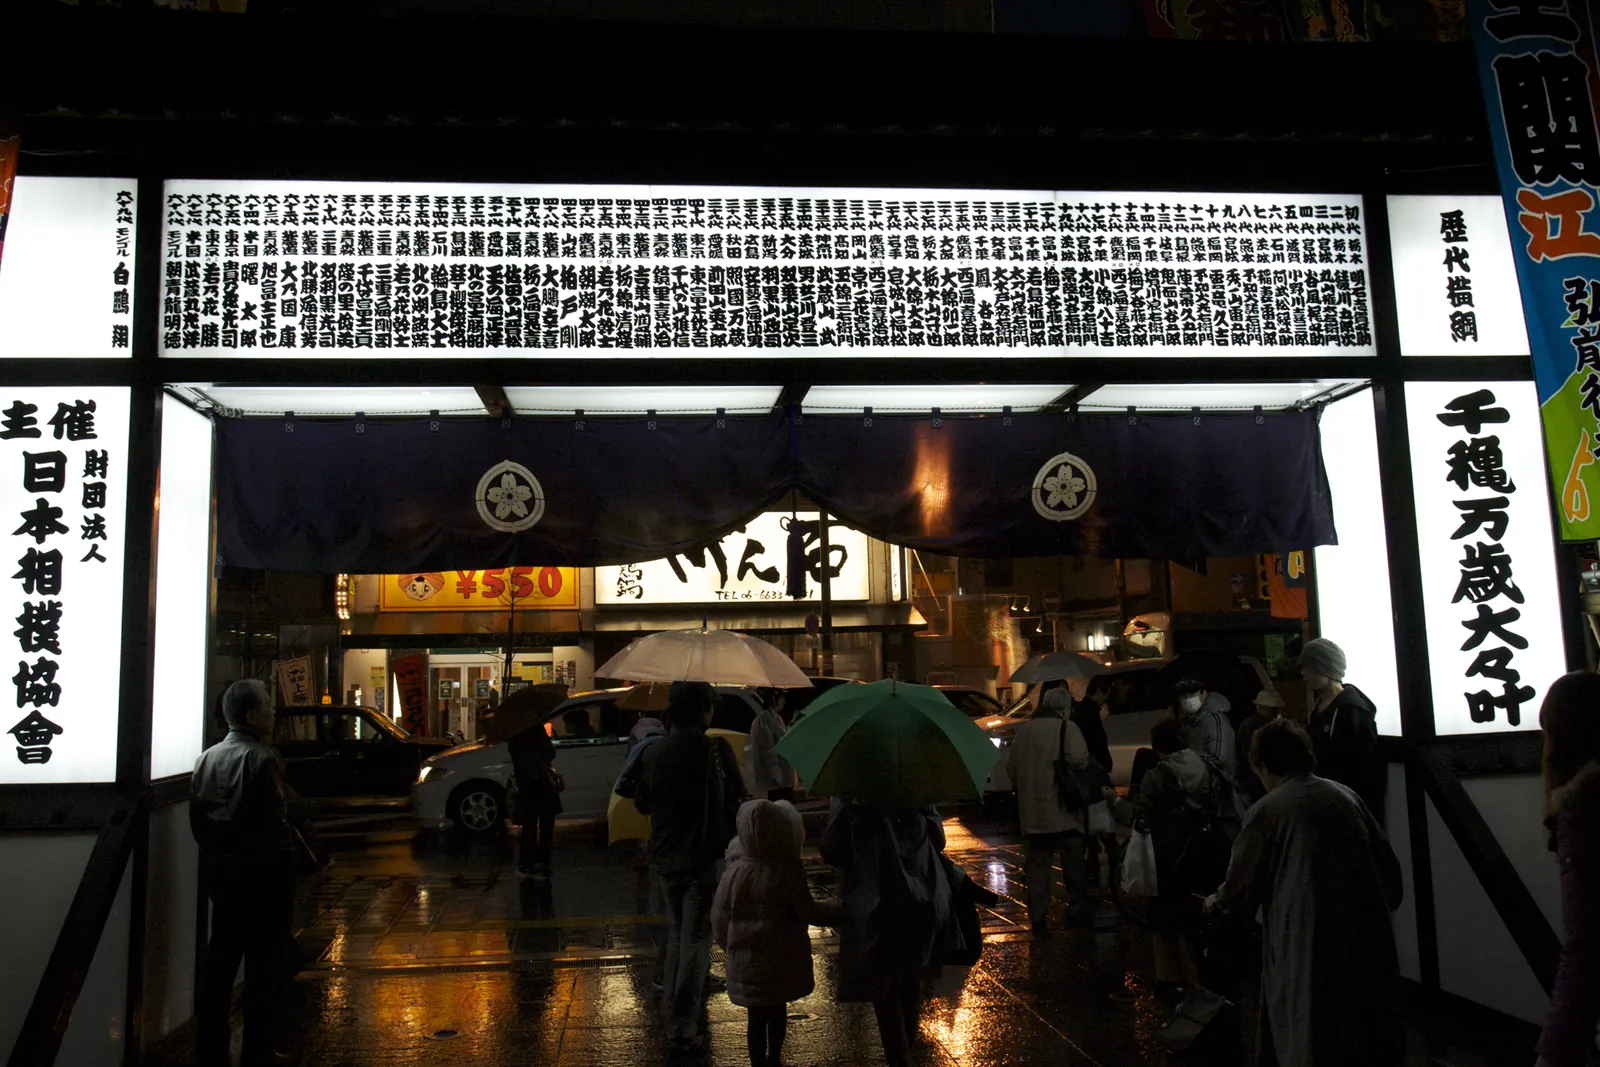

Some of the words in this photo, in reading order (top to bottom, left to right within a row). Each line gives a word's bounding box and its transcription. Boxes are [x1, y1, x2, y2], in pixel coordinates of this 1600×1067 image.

[115, 190, 134, 225] 六十九代
[166, 193, 185, 226] 六十八代
[185, 193, 204, 226] 六十七代
[223, 194, 242, 226] 六十五代
[262, 194, 280, 226] 六十三代
[301, 193, 320, 226] 六十一代
[321, 194, 338, 225] 六十代
[338, 194, 357, 226] 五十九代
[358, 194, 375, 226] 五十八代
[376, 194, 393, 226] 五十七代
[394, 194, 412, 226] 五十六代
[413, 194, 430, 228] 五十五代
[431, 195, 449, 228] 五十四代
[468, 195, 485, 227] 五十二代
[486, 195, 504, 227] 五十一代
[523, 197, 541, 228] 四十九代
[542, 197, 560, 228] 四十八代
[614, 198, 632, 229] 四十四代
[651, 197, 669, 229] 四十二代
[669, 198, 688, 228] 四十一代
[707, 198, 724, 229] 三十九代
[725, 198, 742, 229] 三十八代
[760, 198, 778, 230] 三十六代
[777, 197, 795, 231] 三十五代
[796, 198, 813, 231] 三十四代
[832, 198, 848, 230] 三十二代
[884, 201, 902, 231] 二十九代
[902, 201, 919, 230] 二十八代
[919, 200, 937, 230] 二十七代
[937, 200, 953, 231] 二十六代
[989, 201, 1005, 232] 二十三代
[1022, 201, 1039, 232] 二十一代
[1074, 202, 1091, 233] 十八代
[1090, 202, 1108, 232] 十七代
[1156, 202, 1173, 232] 十三代
[1172, 203, 1189, 233] 十二代
[1189, 204, 1205, 233] 十一代
[1205, 203, 1221, 233] 十代
[1221, 204, 1237, 233] 九代
[1253, 204, 1268, 234] 七代
[1268, 204, 1283, 234] 六代
[1284, 204, 1300, 234] 五代
[1298, 205, 1315, 235] 四代
[1329, 205, 1345, 234] 二代
[1344, 204, 1361, 235] 初代
[115, 228, 130, 257] モンゴル
[1440, 209, 1478, 343] 歴代横綱
[429, 263, 449, 348] 輪島大士
[0, 399, 98, 442] 主催
[80, 449, 109, 563] 財団法人
[7, 449, 70, 765] 日本相撲協會
[714, 590, 739, 600] TEL
